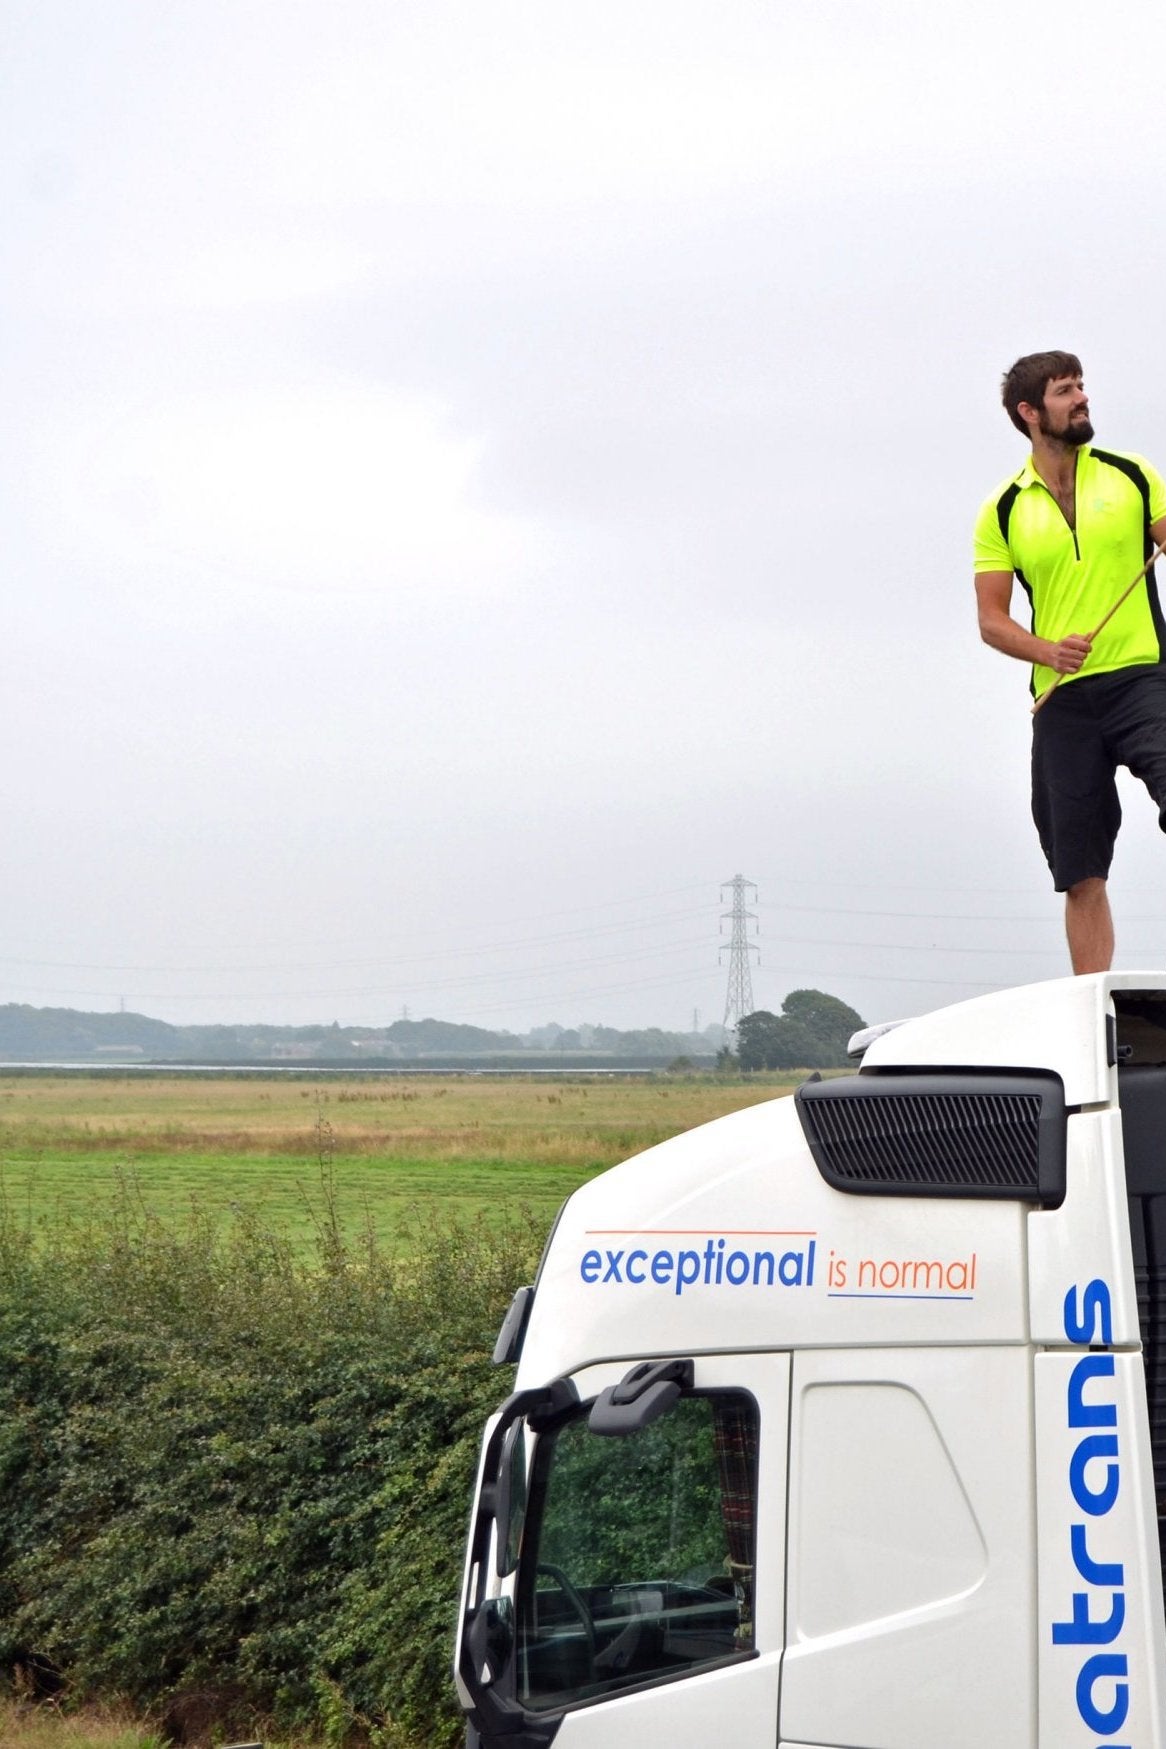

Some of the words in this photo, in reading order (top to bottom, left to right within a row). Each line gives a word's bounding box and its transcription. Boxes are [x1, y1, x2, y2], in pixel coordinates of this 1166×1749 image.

[580, 1239, 816, 1295] exceptional
[828, 1250, 847, 1287] is
[857, 1253, 977, 1290] normal
[1052, 1279, 1132, 1749] atrans
